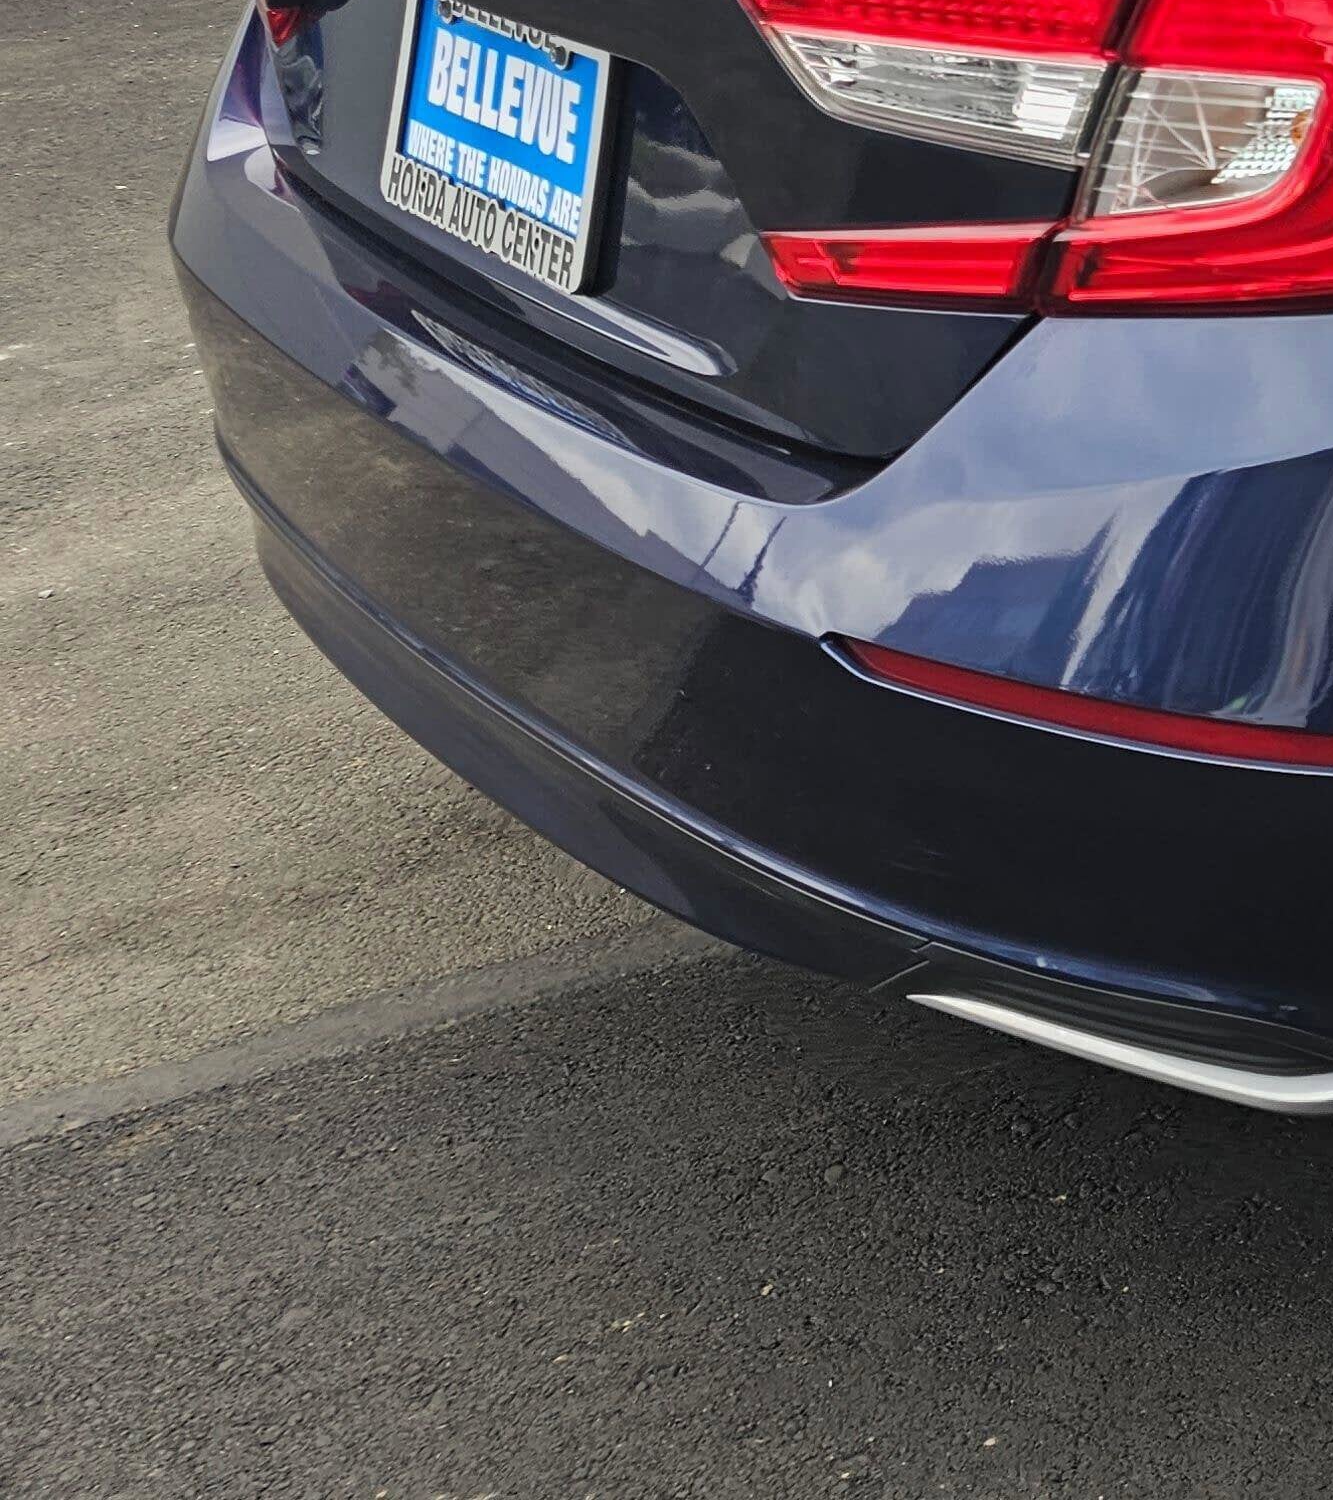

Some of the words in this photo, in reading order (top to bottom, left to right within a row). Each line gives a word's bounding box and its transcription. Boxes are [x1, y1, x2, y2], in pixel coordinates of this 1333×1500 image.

[427, 27, 581, 165] BELLEVUE
[388, 157, 447, 226] HONDA
[450, 187, 498, 249] AUTO
[502, 211, 576, 290] CENTER
[407, 118, 455, 175] WHERE
[457, 142, 488, 188] THE
[488, 156, 549, 219] HONDAS
[549, 186, 582, 236] ARE
